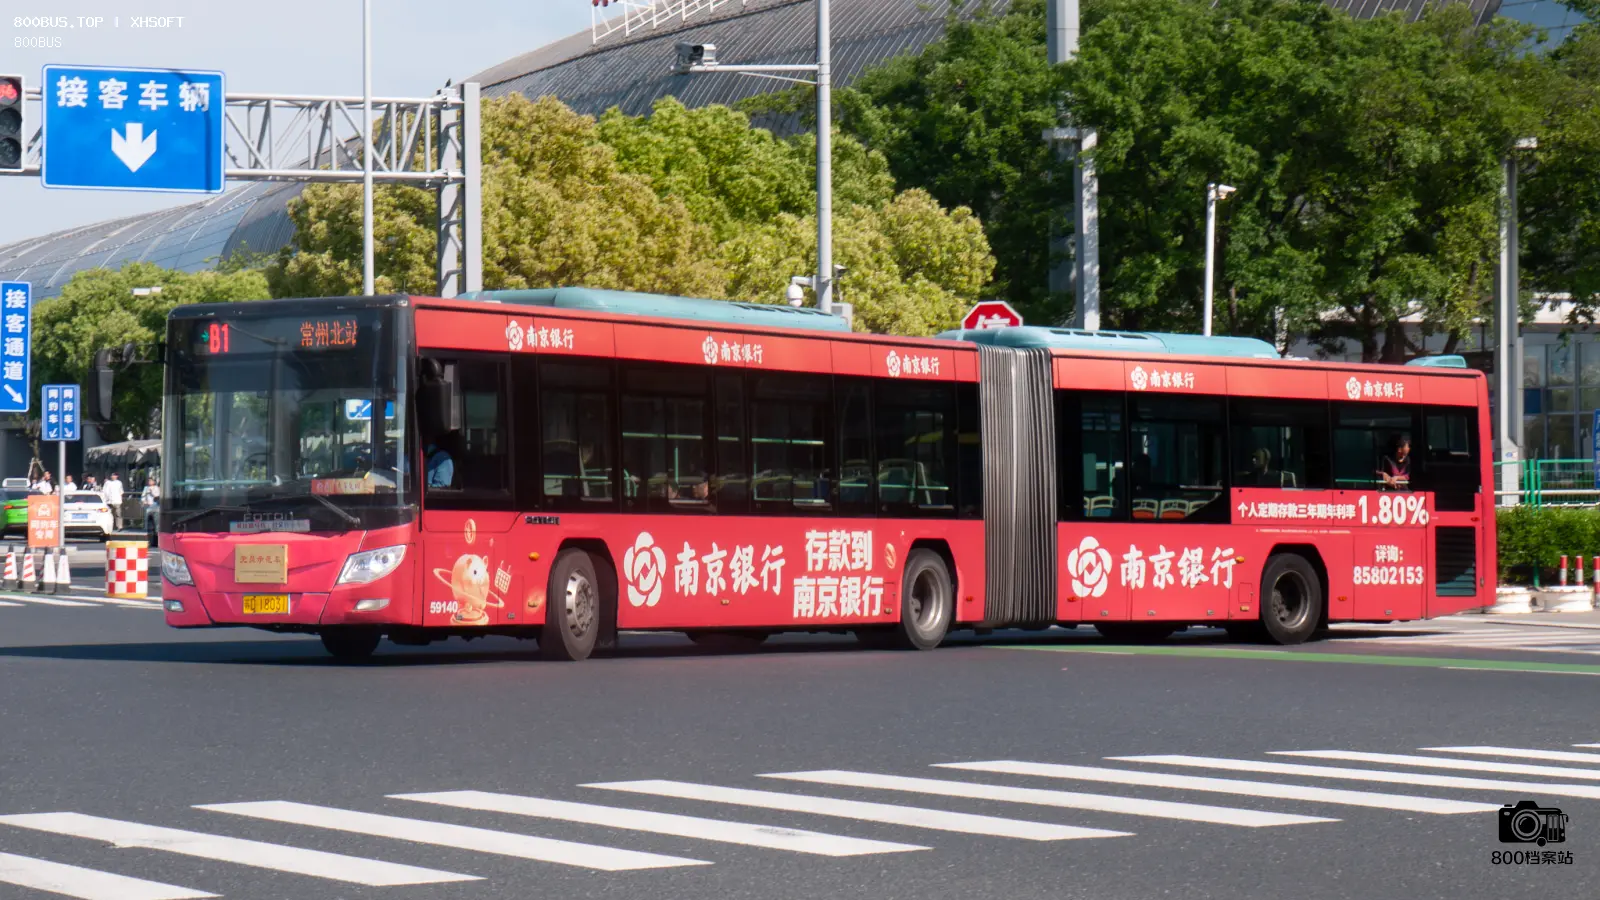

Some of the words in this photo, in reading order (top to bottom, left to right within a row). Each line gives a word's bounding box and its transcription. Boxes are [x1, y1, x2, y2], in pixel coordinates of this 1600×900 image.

[56, 75, 210, 112] 接客车辆
[4, 289, 26, 381] 接客通道
[299, 320, 358, 347] 常州北站
[526, 326, 575, 349] 南京银行
[720, 342, 763, 364] 南京银行
[903, 355, 940, 376] 南京银行
[1150, 368, 1195, 390] 南京银行
[1364, 380, 1405, 399] 南京银行
[1237, 501, 1356, 520] 个人定期存款三年期年利率
[1358, 495, 1429, 525] 1.80%
[805, 530, 874, 572] 存款到
[674, 542, 786, 597] 南京银行
[1120, 544, 1237, 589] 南京银行
[1352, 566, 1424, 585] 85802153
[259, 596, 286, 611] 18031
[430, 601, 458, 614] 59140
[793, 576, 885, 618] 南京银行
